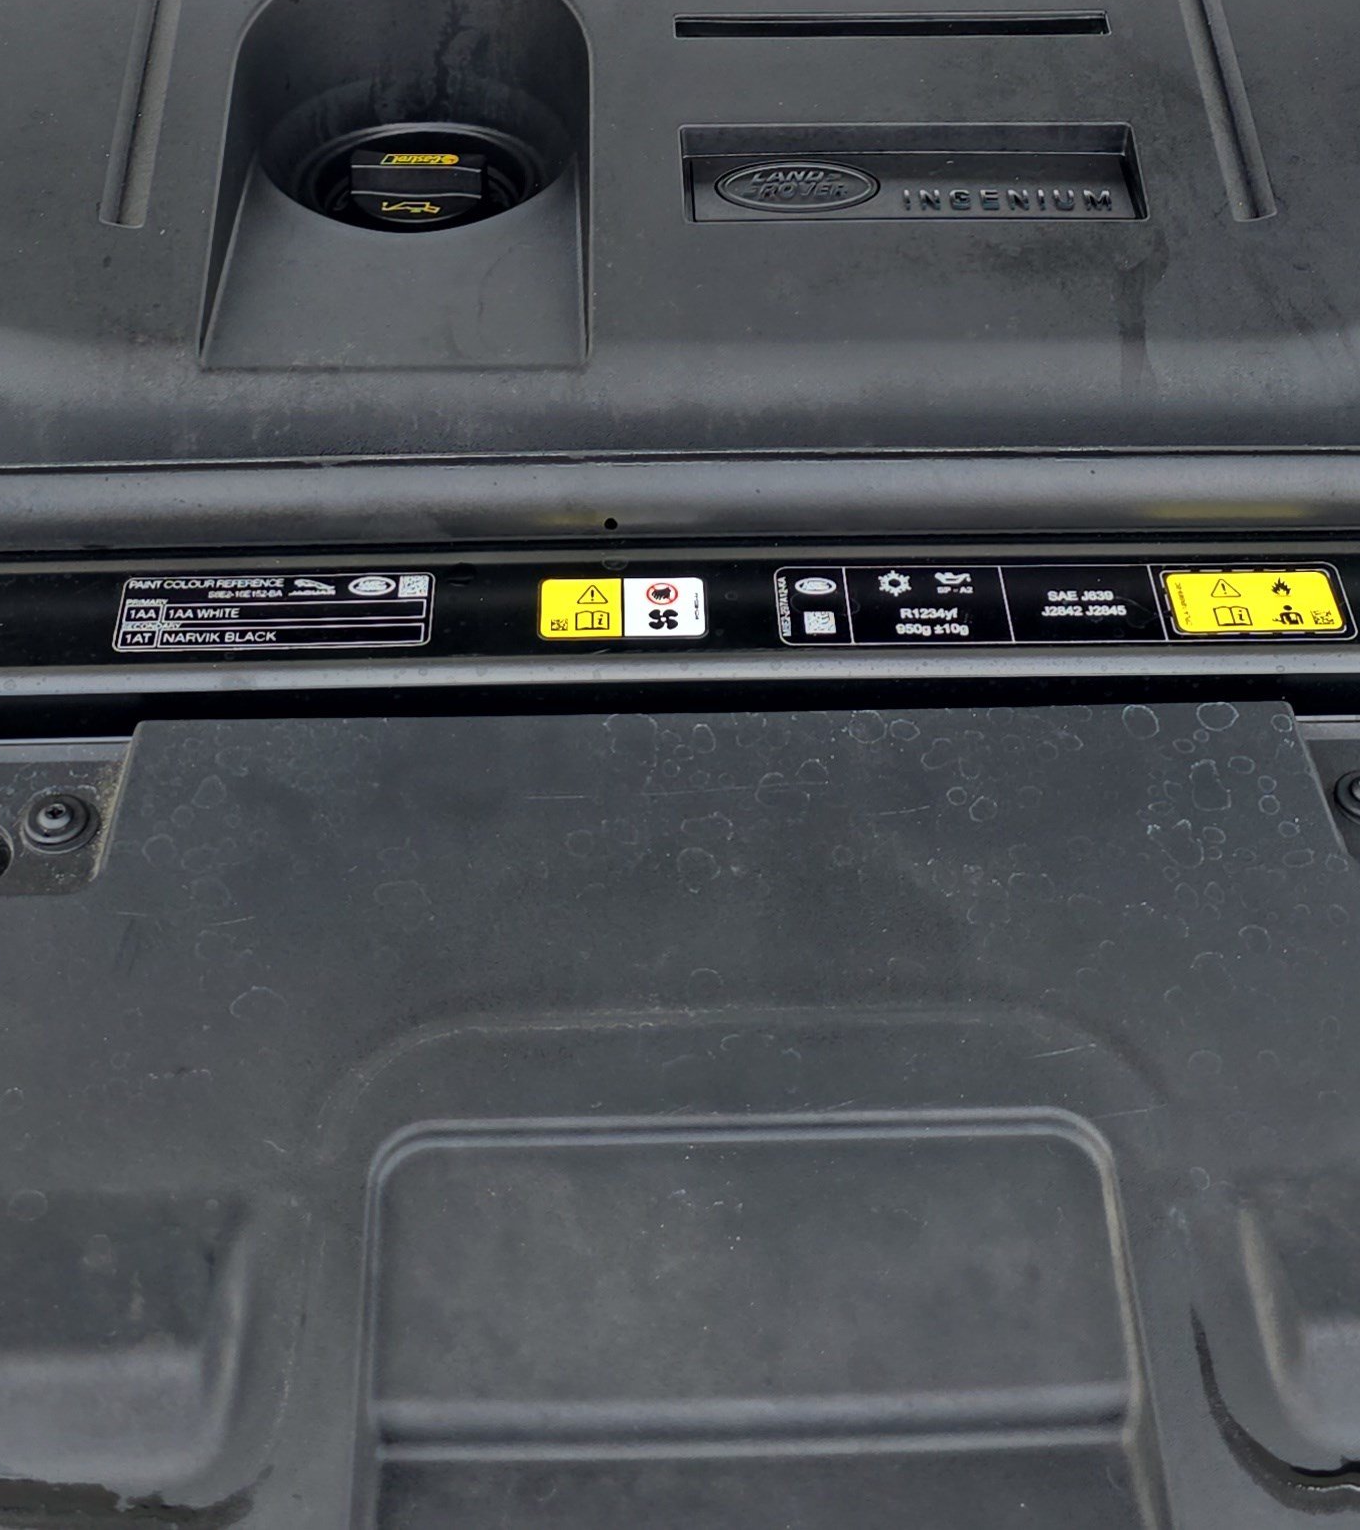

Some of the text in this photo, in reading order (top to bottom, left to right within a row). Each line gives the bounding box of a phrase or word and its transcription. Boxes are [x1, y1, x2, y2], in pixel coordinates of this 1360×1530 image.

[395, 154, 442, 165] Castrol
[750, 170, 824, 183] LAND
[758, 181, 848, 198] ROVER
[903, 188, 1114, 212] INGENIUM
[129, 578, 285, 589] PAINT COLOUR REFERENCE
[1047, 591, 1079, 601] SAE
[129, 609, 156, 619] 1AA
[168, 607, 240, 619] 1AA WHITE
[900, 608, 958, 619] R1234yf
[1041, 606, 1083, 616] J2842
[124, 633, 152, 644] 1AT
[162, 631, 277, 643] NARVIK BLACK
